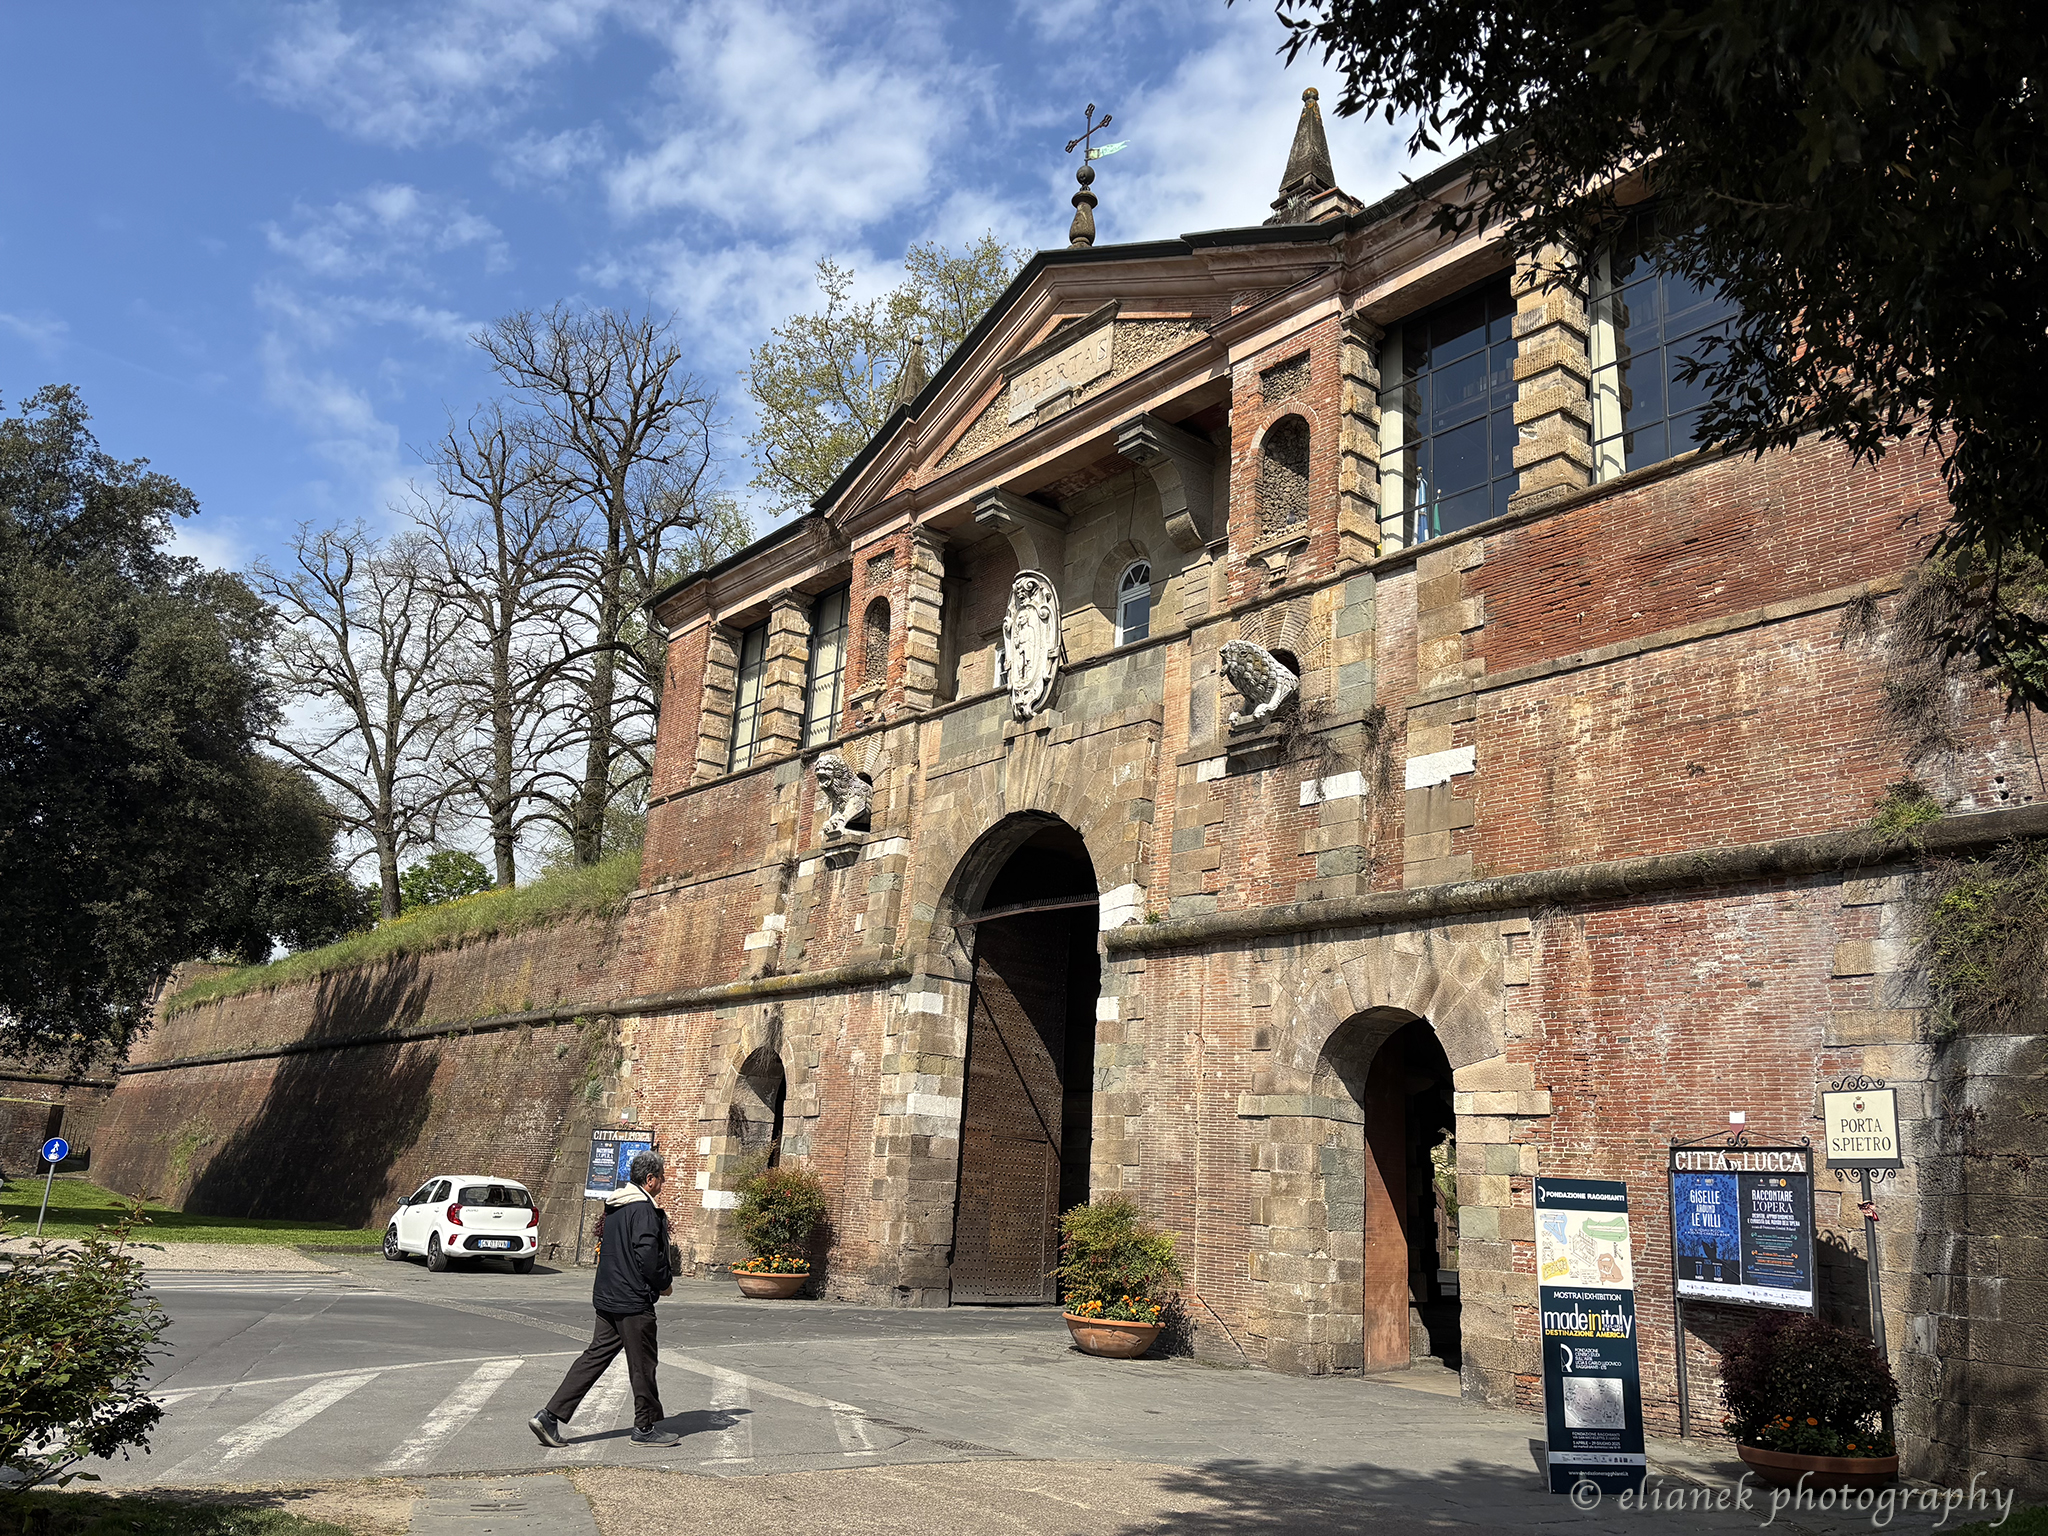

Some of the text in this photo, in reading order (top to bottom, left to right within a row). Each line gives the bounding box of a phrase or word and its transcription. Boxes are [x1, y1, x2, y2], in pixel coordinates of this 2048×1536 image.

[1840, 1117, 1883, 1133] PORTA
[625, 1131, 651, 1142] LUCCA
[1832, 1136, 1892, 1152] S.PIETRO
[1743, 1151, 1805, 1173] LUCCA
[1546, 1191, 1586, 1200] FONDAZIONE
[1587, 1193, 1625, 1202] RAGGHIANTI
[1690, 1189, 1720, 1205] GISELLE
[1751, 1189, 1794, 1203] RACCONTARE
[1752, 1201, 1794, 1214] L'OPERA
[1692, 1213, 1721, 1228] LE VILLI
[1695, 1264, 1722, 1277] 17 18
[1545, 1329, 1626, 1339] DESTINAZIONE AMERICA
